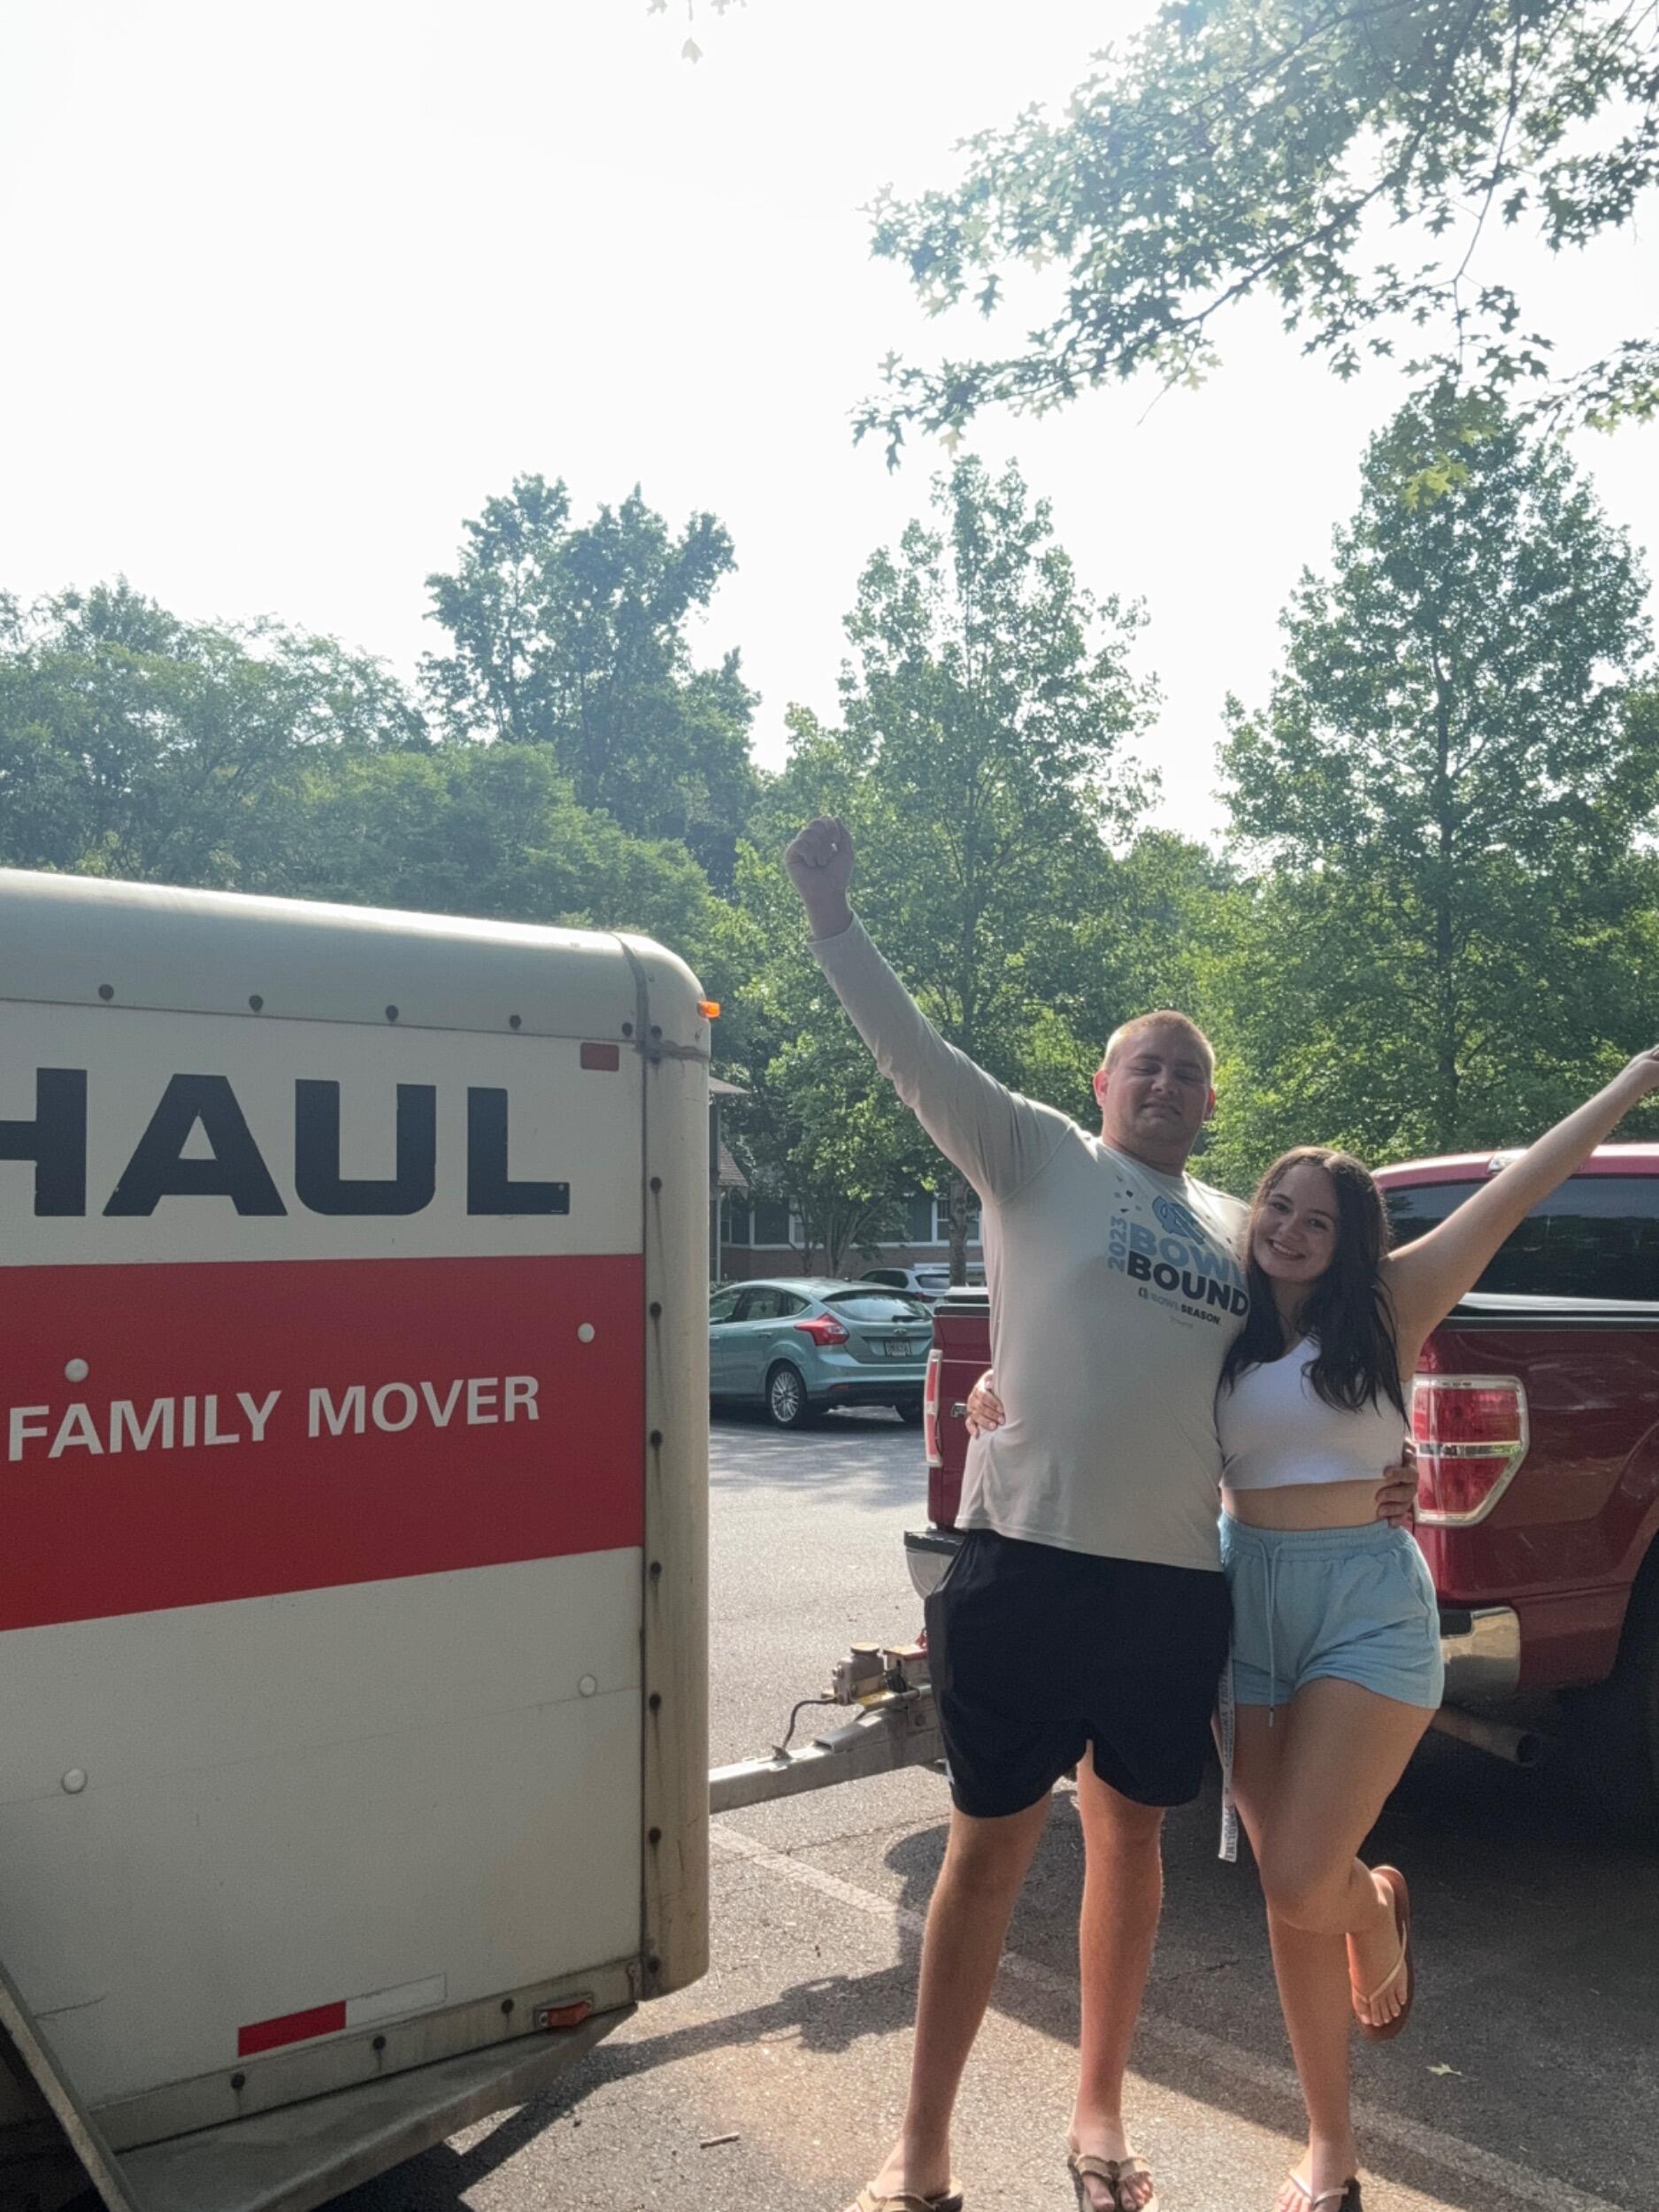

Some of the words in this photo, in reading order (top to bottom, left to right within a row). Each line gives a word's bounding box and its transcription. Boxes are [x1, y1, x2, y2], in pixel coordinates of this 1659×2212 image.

[1108, 1215, 1128, 1273] 2023
[1127, 1250, 1249, 1317] BOUND
[1181, 1303, 1221, 1325] SEASON
[8, 1390, 282, 1462] FAMILY
[307, 1375, 541, 1439] MOVER
